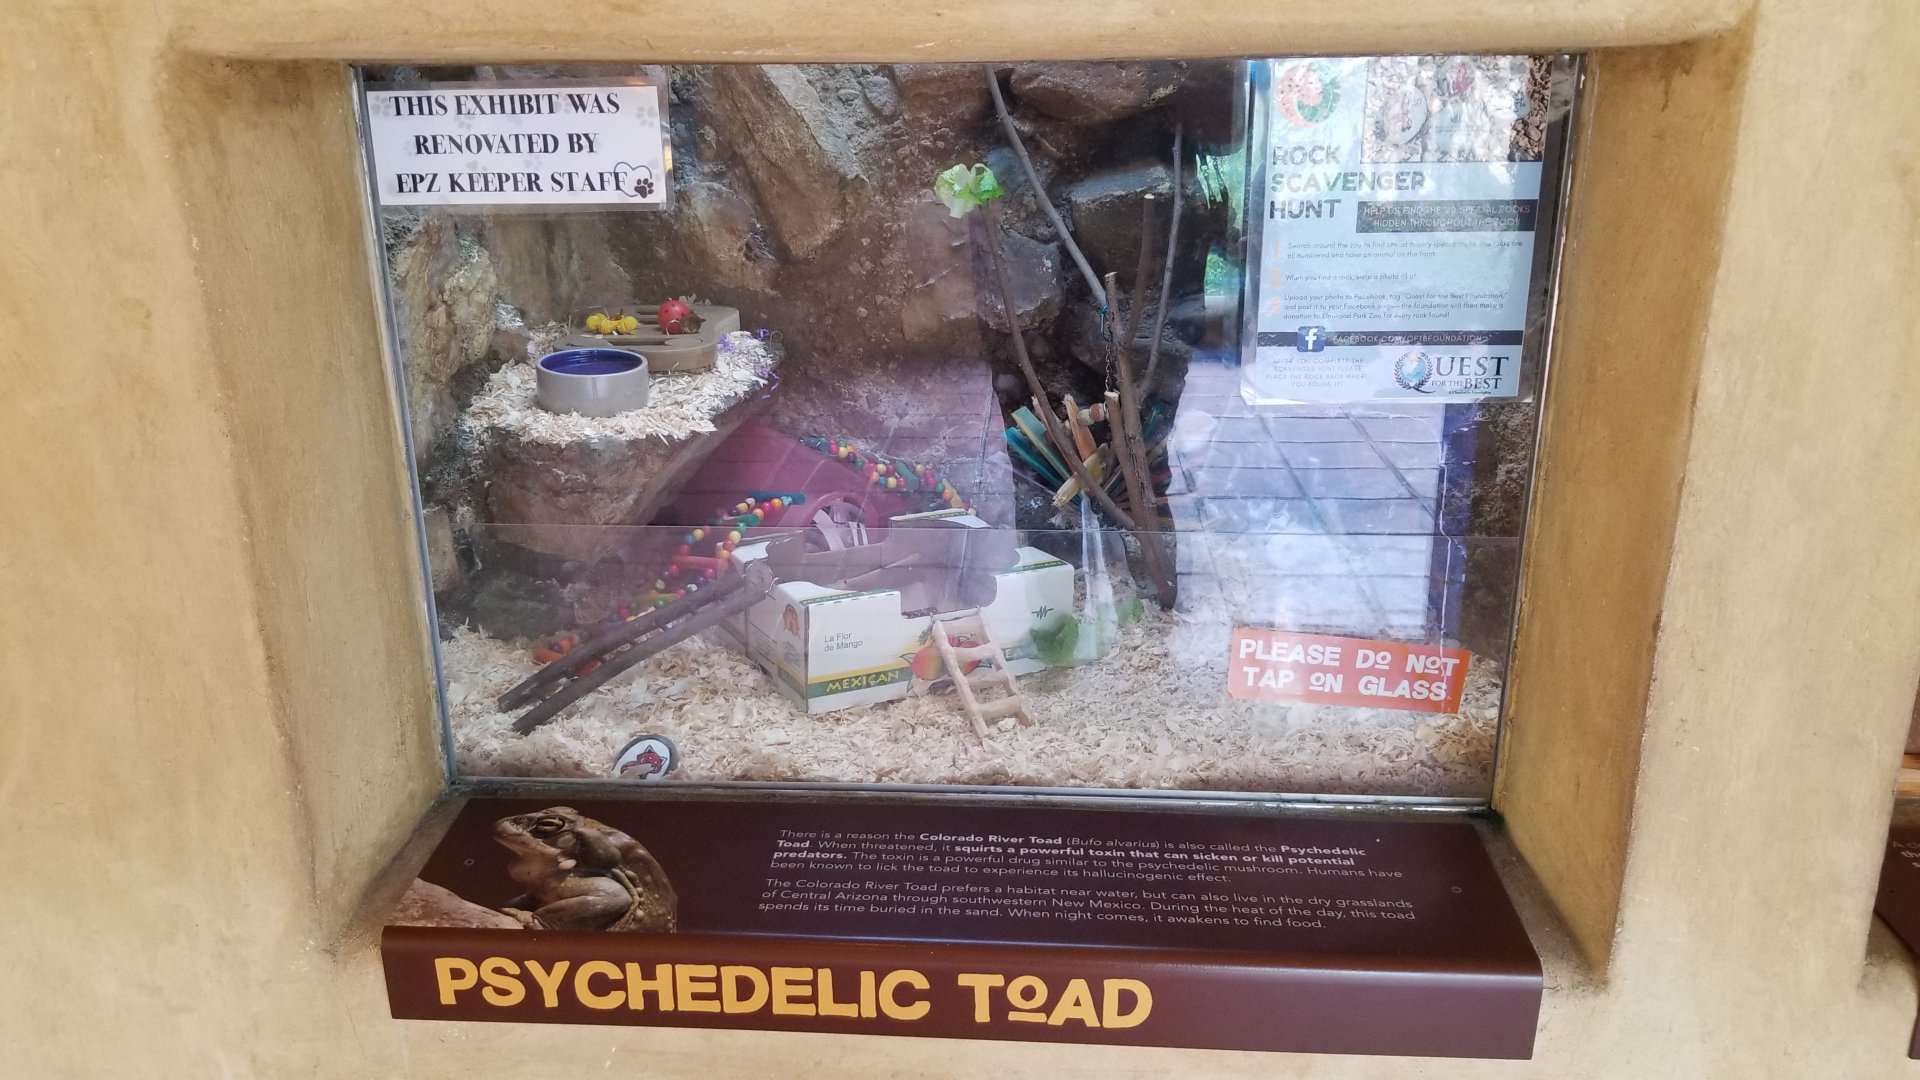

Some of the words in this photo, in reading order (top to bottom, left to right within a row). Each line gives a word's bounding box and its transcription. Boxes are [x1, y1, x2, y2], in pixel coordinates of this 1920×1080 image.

[389, 94, 448, 117] THIS
[455, 93, 559, 116] EXHIBIT
[567, 92, 620, 114] WAS
[414, 132, 559, 155] RENOVATED
[568, 132, 598, 153] BY
[1272, 144, 1341, 166] ROCK
[396, 172, 440, 193] EPZ
[449, 171, 543, 193] KEEPER
[551, 170, 628, 192] STAFF
[1270, 171, 1426, 193] SCAVENGER
[1269, 198, 1341, 219] HUNT
[1373, 218, 1407, 228] HIDDEN
[1283, 312, 1312, 320] donation
[1464, 377, 1503, 389] BEST
[824, 633, 834, 643] La
[824, 643, 834, 652] de
[836, 640, 864, 652] Mango
[1239, 638, 1342, 667] PLEASE
[826, 671, 899, 693] MEXICAN
[1242, 666, 1295, 689] TAP
[1358, 675, 1448, 701] GLASS
[776, 839, 813, 848] Toad.
[818, 840, 857, 849] When
[861, 841, 937, 852] threatened,
[942, 844, 951, 852] it
[954, 844, 1003, 856] squirts
[1019, 846, 1084, 856] powerful
[1087, 848, 1126, 858] toxin
[1128, 849, 1160, 859] that
[1163, 852, 1189, 860] can
[1192, 852, 1238, 862] sicken
[1261, 854, 1284, 864] kill
[1287, 854, 1355, 866] potential
[780, 829, 817, 838] There
[821, 830, 831, 839] is
[894, 832, 916, 841] the
[919, 832, 984, 843] Colorado
[988, 834, 1025, 844] River
[1028, 835, 1063, 845] Toad
[1066, 837, 1103, 849] (Bufo
[1106, 838, 1160, 851] alvarius)
[1164, 840, 1175, 849] is
[1178, 841, 1206, 850] also
[1209, 842, 1250, 852] called
[1254, 843, 1277, 853] the
[1280, 844, 1367, 856] Psychedelic
[770, 859, 805, 869] been
[809, 860, 853, 870] known
[858, 863, 872, 871] to
[876, 862, 898, 871] lick
[902, 863, 925, 872] the
[928, 864, 960, 873] toad
[964, 865, 979, 873] to
[982, 866, 1059, 877] experience
[1063, 868, 1079, 877] its
[1082, 868, 1184, 882] hallucinogenic
[1187, 872, 1231, 883] effect.
[772, 850, 848, 862] predators.
[854, 851, 878, 860] The
[881, 853, 914, 861] toxin
[919, 853, 929, 861] is
[945, 854, 1004, 866] powerful
[1008, 855, 1041, 867] drug
[1045, 857, 1089, 866] similar
[1092, 859, 1107, 867] to
[1110, 859, 1134, 868] the
[1138, 861, 1220, 871] psychedelic
[1223, 864, 1303, 874] mushroom.
[1306, 866, 1366, 877] Humans
[1367, 868, 1403, 878] have
[761, 889, 778, 898] of
[780, 889, 832, 900] Central
[834, 891, 888, 902] Arizona
[892, 892, 948, 905] through
[952, 895, 1047, 907] southwestern
[1052, 897, 1085, 908] New
[1089, 899, 1145, 910] Mexico.
[1150, 901, 1200, 914] During
[1203, 903, 1228, 913] the
[1231, 904, 1265, 915] heat
[1268, 905, 1284, 915] of
[1287, 906, 1312, 916] the
[1316, 907, 1346, 920] day,
[1349, 908, 1378, 919] this
[1379, 910, 1416, 920] toad
[767, 878, 792, 888] The
[795, 879, 861, 889] Colorado
[865, 880, 900, 890] River
[903, 882, 938, 892] Toad
[941, 883, 991, 897] prefers
[994, 886, 1002, 894] a
[1007, 884, 1057, 895] habitat
[1095, 890, 1138, 900] water,
[1142, 889, 1168, 900] but
[1171, 893, 1196, 901] can
[1200, 891, 1229, 902] also
[1233, 892, 1258, 903] live
[1262, 894, 1276, 904] in
[1279, 895, 1304, 905] the
[1307, 896, 1331, 908] dry
[1335, 898, 1413, 908] grasslands
[758, 902, 809, 913] spends
[813, 903, 830, 912] its
[834, 903, 866, 913] time
[869, 904, 917, 914] buried
[920, 905, 933, 915] in
[937, 906, 961, 915] the
[965, 908, 1003, 917] sand.
[1008, 908, 1050, 918] When
[1054, 910, 1093, 922] night
[1096, 913, 1149, 923] comes,
[1153, 913, 1163, 923] it
[1167, 914, 1230, 925] awakens
[1232, 917, 1250, 926] to
[1253, 916, 1283, 927] find
[1285, 918, 1326, 929] food.
[434, 957, 931, 1020] PSYCHEDELIC
